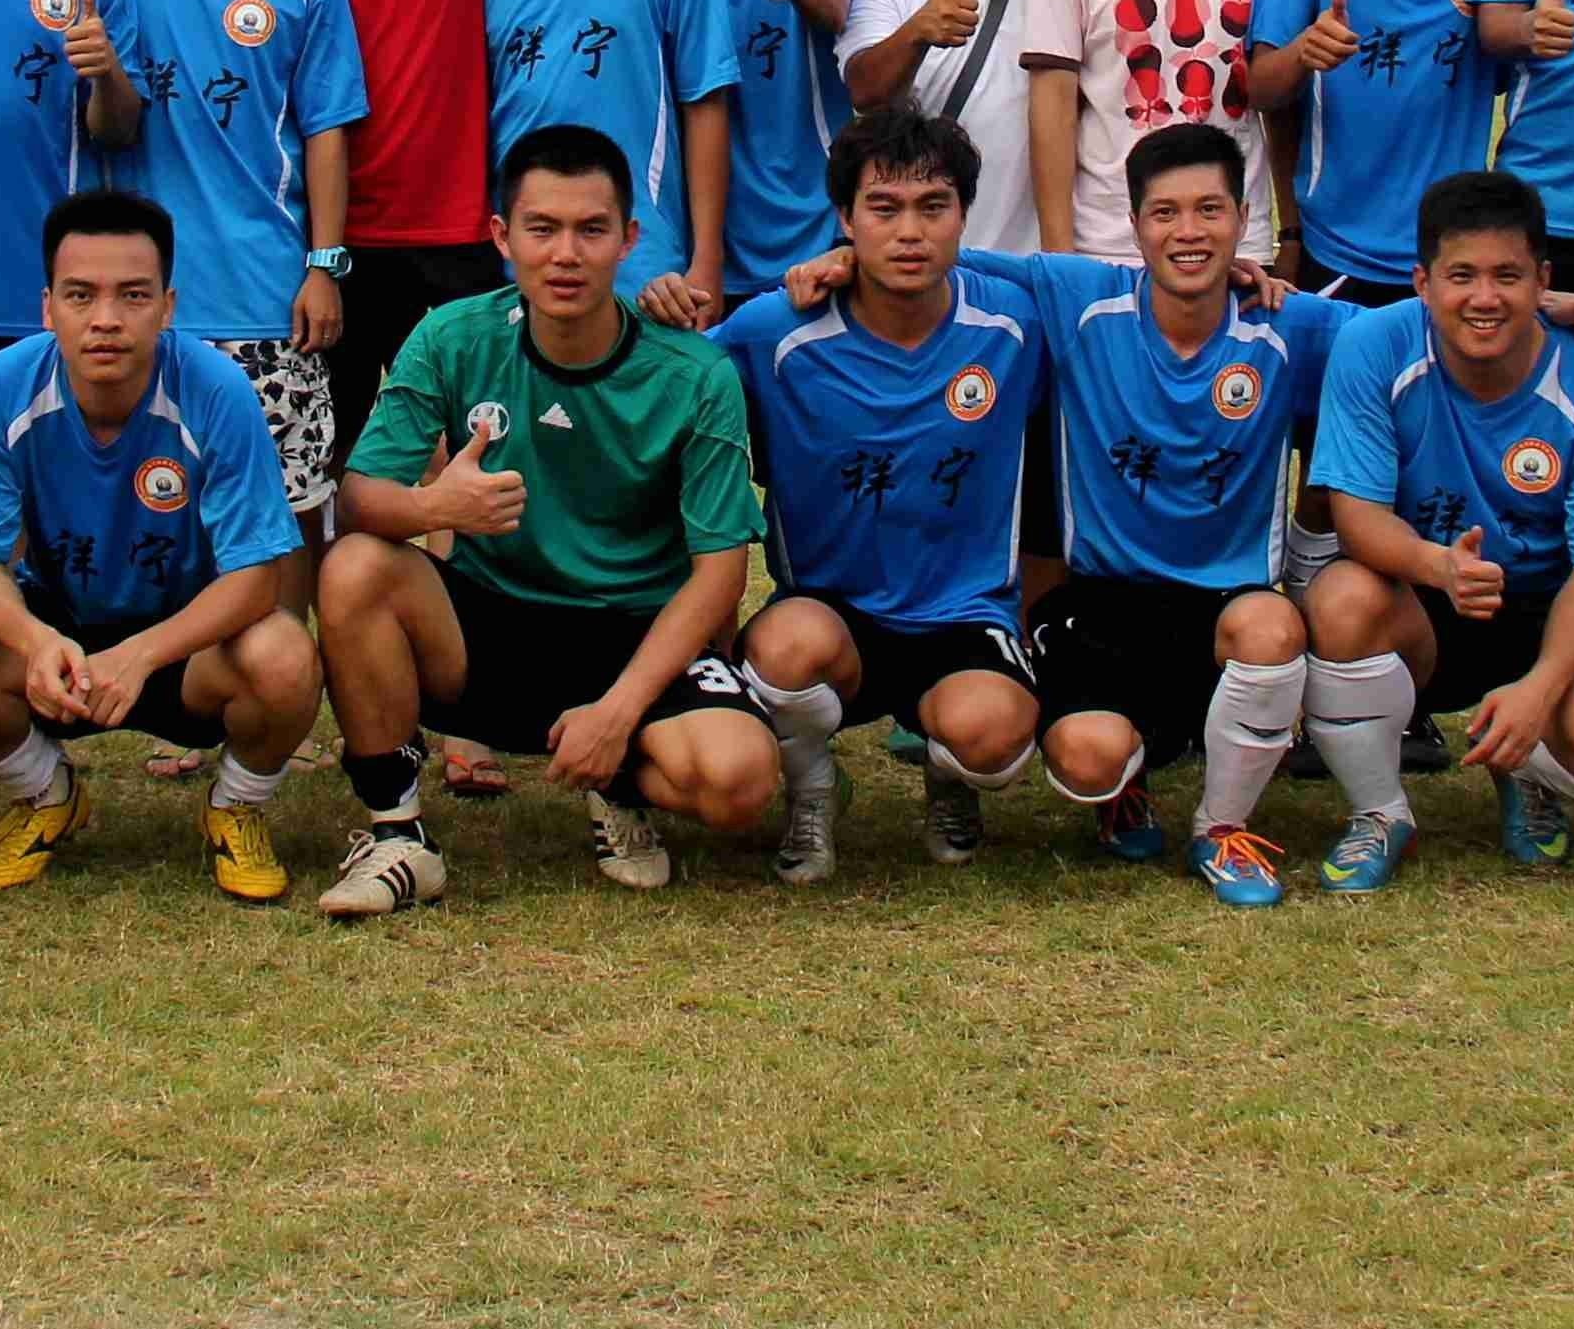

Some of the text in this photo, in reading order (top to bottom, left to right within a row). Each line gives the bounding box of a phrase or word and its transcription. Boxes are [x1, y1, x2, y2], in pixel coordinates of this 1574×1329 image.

[505, 17, 620, 81] 祥宁
[1358, 27, 1467, 90] 祥宁
[840, 443, 977, 513] 祥宁
